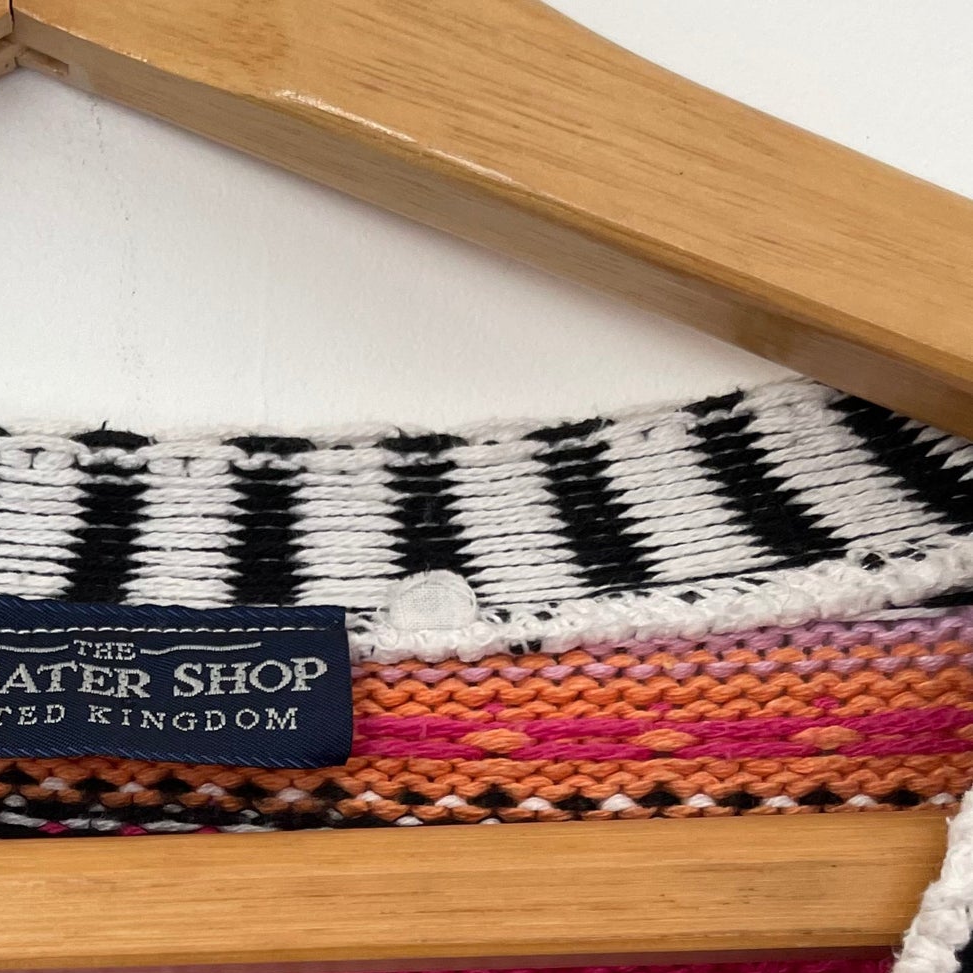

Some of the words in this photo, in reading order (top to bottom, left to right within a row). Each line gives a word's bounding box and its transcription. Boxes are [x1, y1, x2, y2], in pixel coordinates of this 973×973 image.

[73, 640, 136, 661] THE
[173, 656, 328, 698] SHOP
[88, 705, 299, 731] KINGDOM
